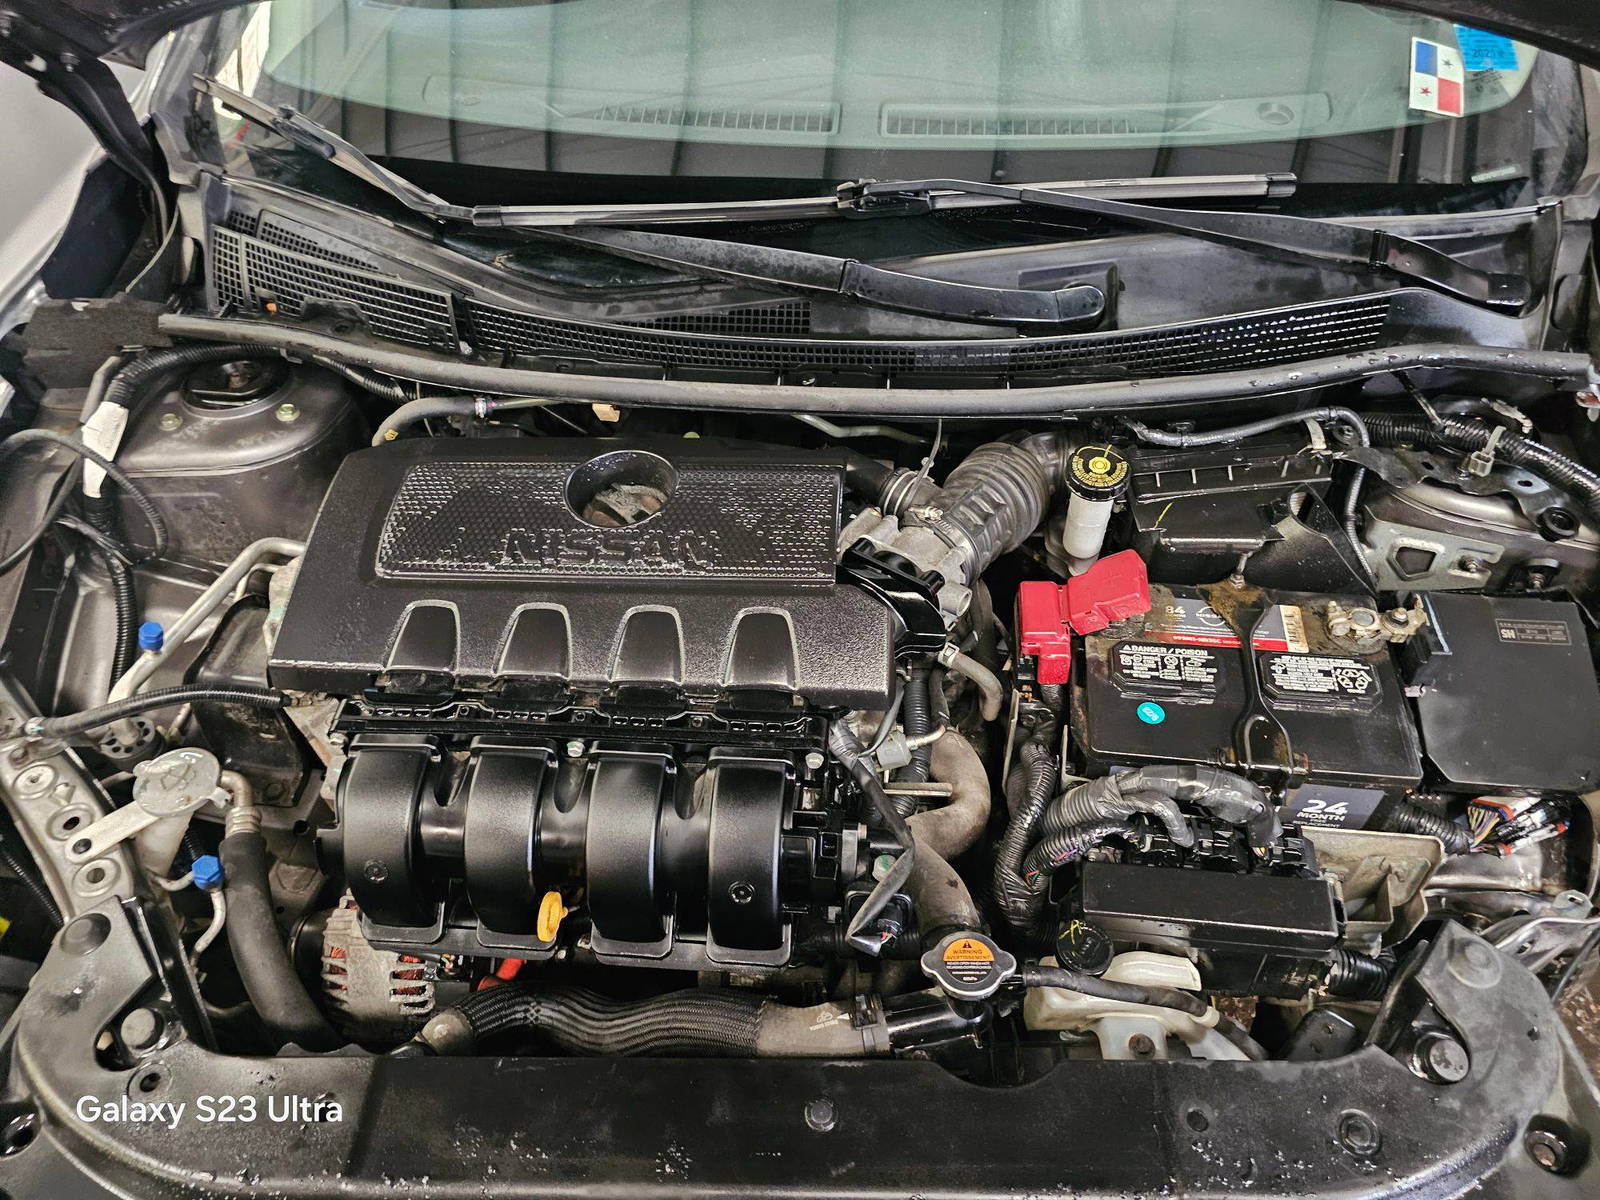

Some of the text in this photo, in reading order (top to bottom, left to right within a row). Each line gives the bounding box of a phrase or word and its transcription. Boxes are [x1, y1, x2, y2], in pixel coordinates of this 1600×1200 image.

[499, 528, 720, 567] NISSAN
[1131, 645, 1167, 653] DANGER
[1175, 648, 1208, 656] POISON
[1301, 799, 1349, 815] 24
[1296, 811, 1346, 821] MONTH
